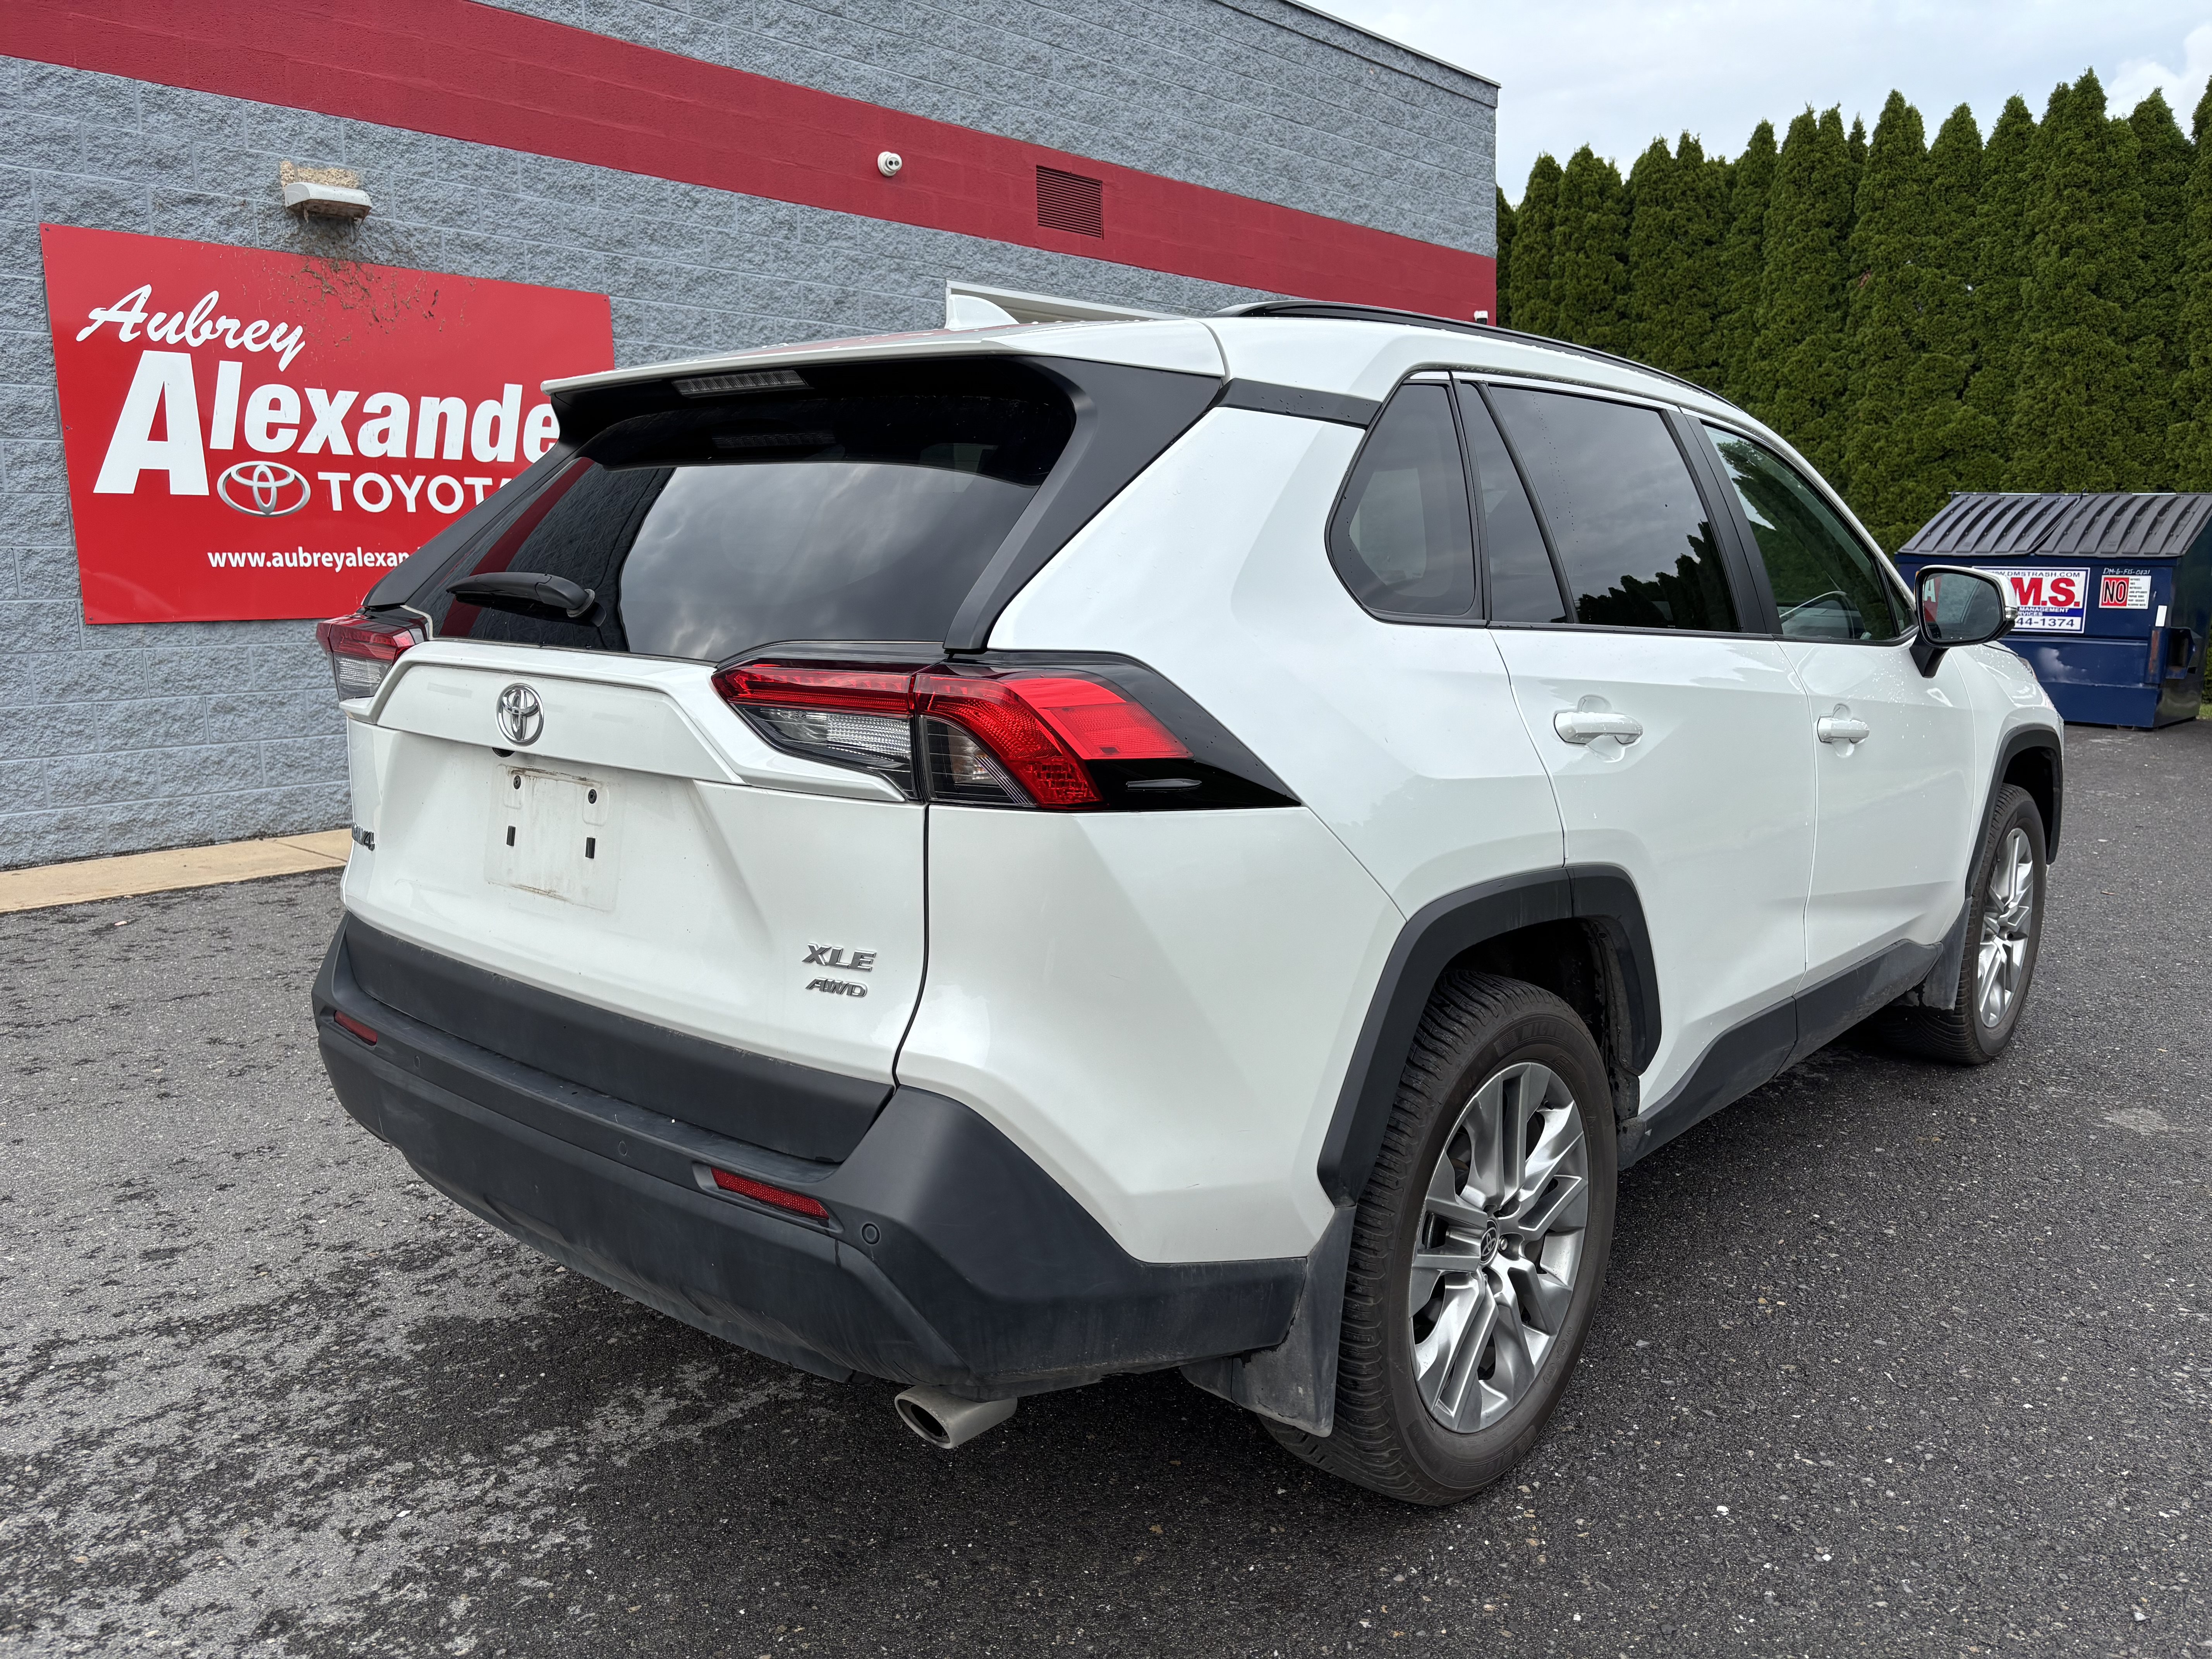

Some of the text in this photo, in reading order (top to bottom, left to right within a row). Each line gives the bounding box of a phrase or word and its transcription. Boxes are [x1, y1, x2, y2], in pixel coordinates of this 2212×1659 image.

[76, 284, 305, 372] Aubrey
[318, 472, 512, 514] TOYOT
[207, 546, 422, 573] www.aubreyalexan
[2103, 580, 2127, 604] NO
[802, 943, 877, 972] XLE
[805, 977, 867, 998] AWD
